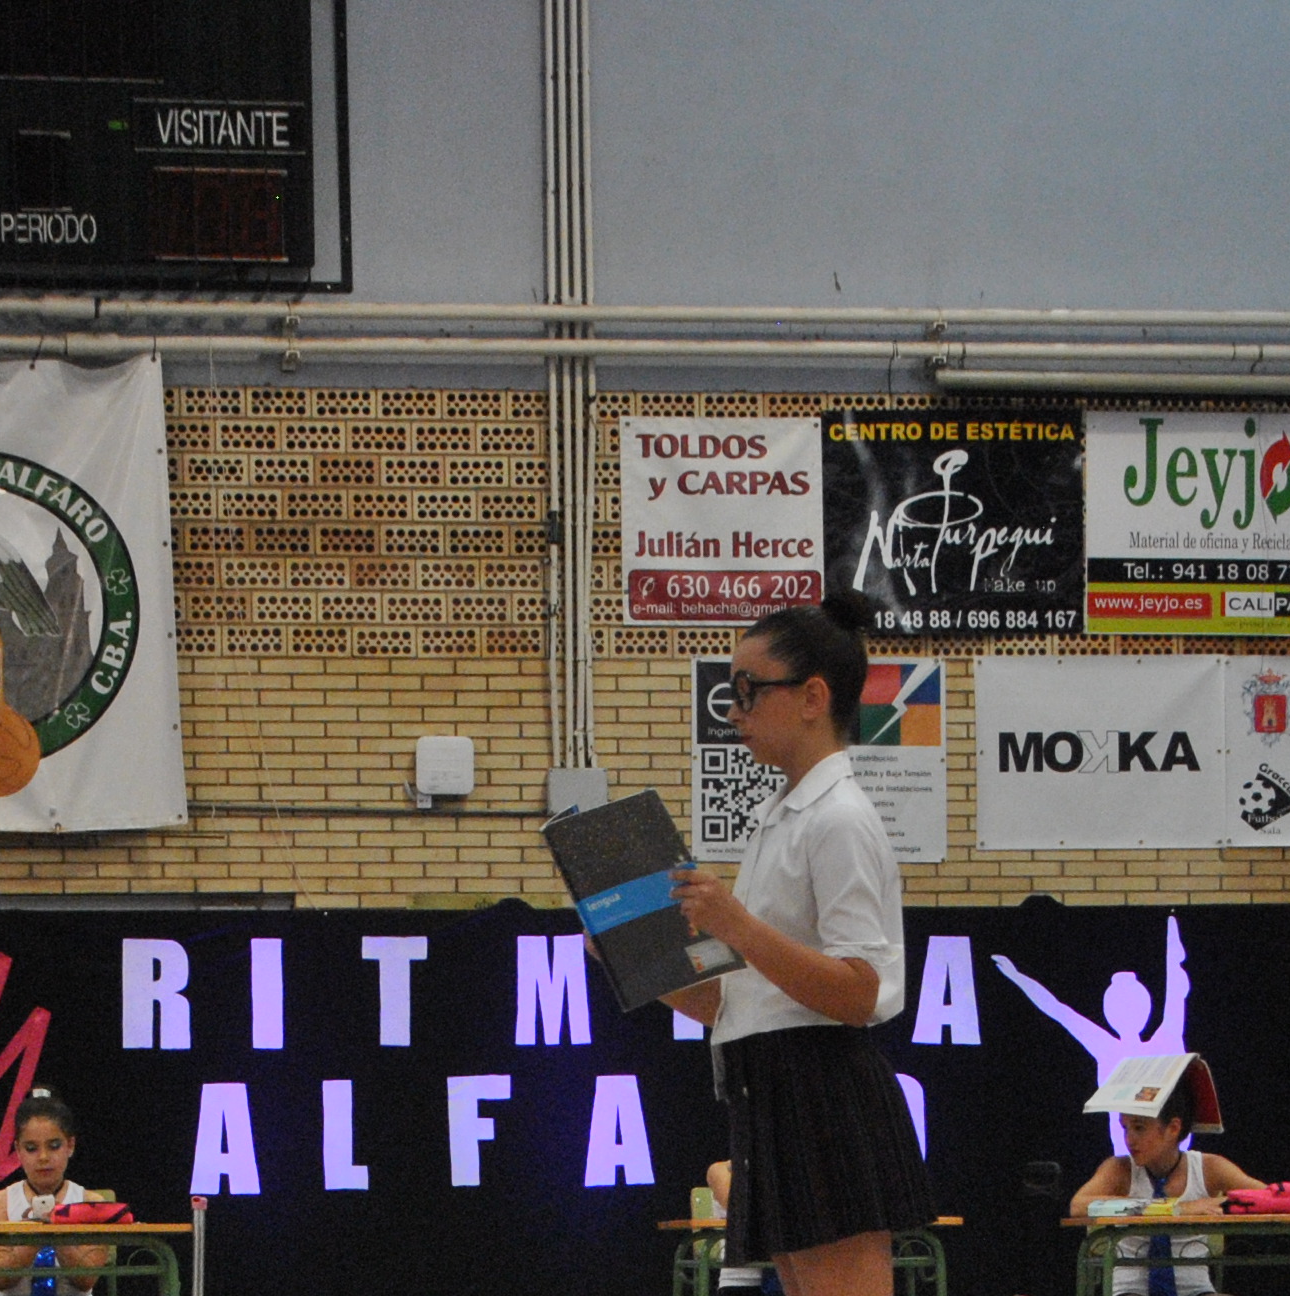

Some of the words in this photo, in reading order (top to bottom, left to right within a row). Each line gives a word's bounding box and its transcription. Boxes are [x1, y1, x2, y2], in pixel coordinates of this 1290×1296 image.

[157, 107, 289, 147] VISITANTE
[0, 213, 97, 243] PERIODO
[829, 423, 922, 441] CENTRO
[930, 423, 958, 441] DE
[635, 433, 768, 459] TOLDOS
[648, 476, 667, 501] y
[677, 470, 810, 495] CARPAS
[635, 531, 721, 558] Julián
[732, 531, 814, 558] Herce
[1129, 532, 1179, 549] Material
[1183, 532, 1197, 549] de
[1200, 532, 1238, 549] oficina
[1242, 537, 1249, 553] y
[1123, 562, 1163, 579] Tel.:
[1172, 563, 1207, 579] 941
[1217, 563, 1239, 579] 18
[1246, 564, 1269, 580] 08
[666, 574, 709, 599] 630
[718, 575, 761, 599] 466
[770, 576, 812, 600] 202
[632, 602, 676, 615] e-mail:
[1094, 593, 1203, 612] www.jeyjo.es
[874, 611, 895, 628] 18
[901, 611, 921, 628] 48
[929, 611, 951, 628] 88
[967, 611, 1000, 628] 696
[1006, 611, 1038, 628] 884
[1045, 611, 1076, 628] 167
